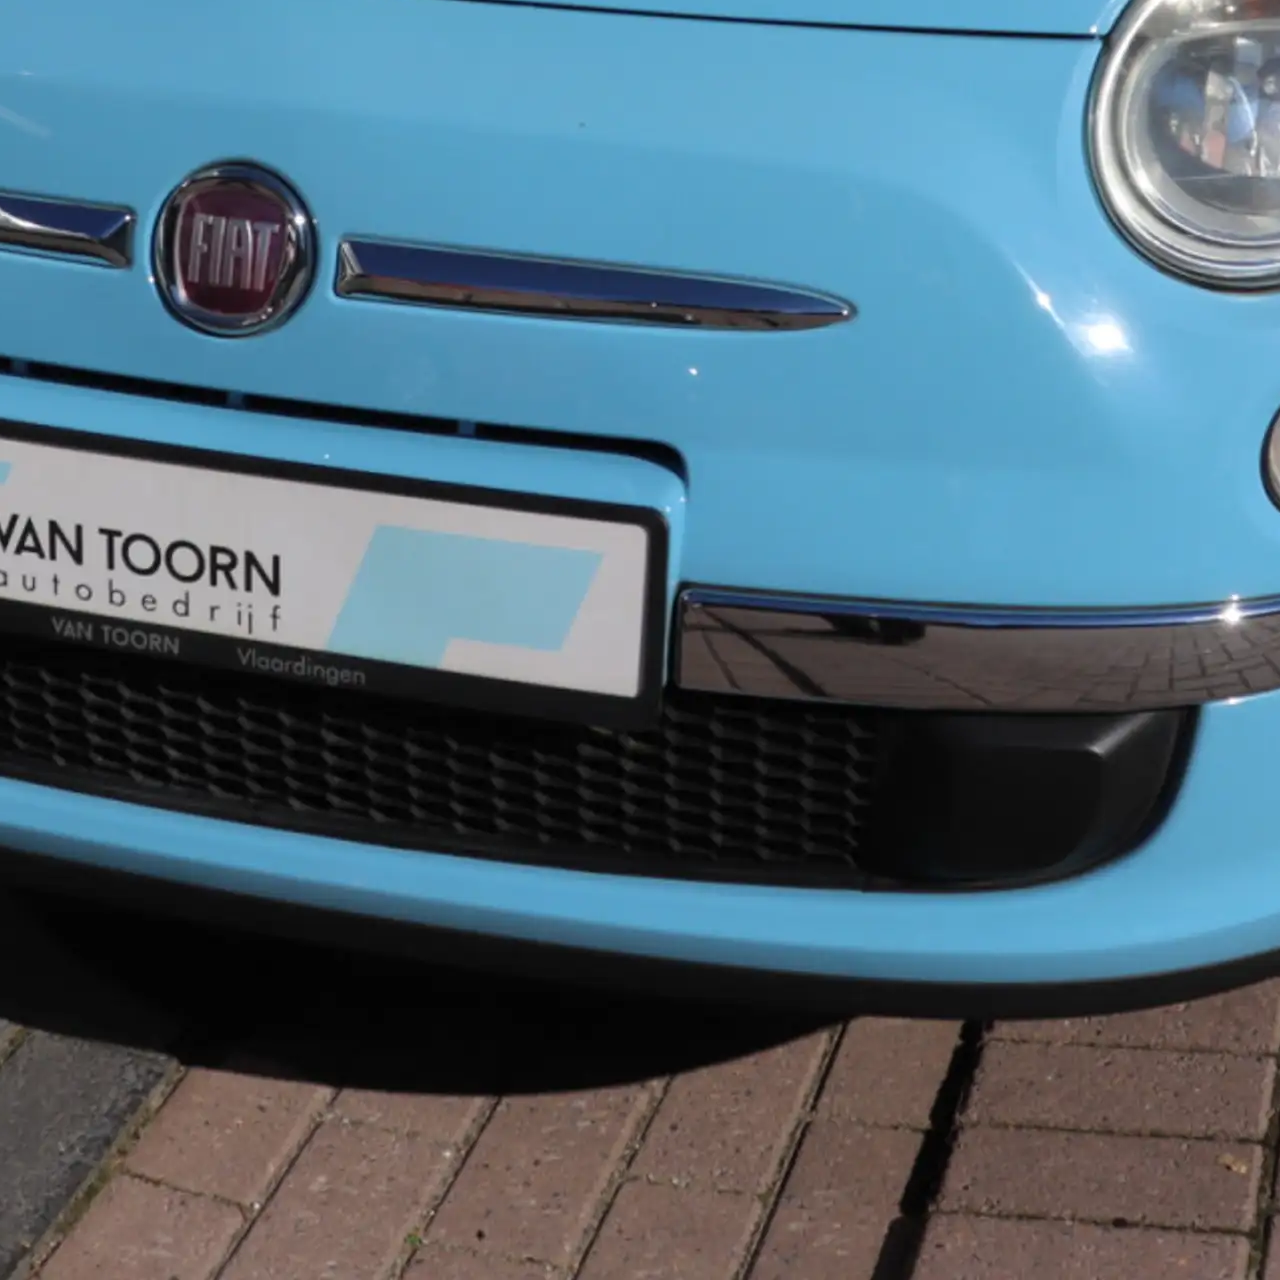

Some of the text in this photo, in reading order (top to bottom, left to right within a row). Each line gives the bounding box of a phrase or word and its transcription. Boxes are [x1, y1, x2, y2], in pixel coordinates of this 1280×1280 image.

[187, 212, 280, 292] FIAT
[98, 527, 280, 597] TOORN
[50, 616, 367, 687] VAN TOORN Vlaardingen
